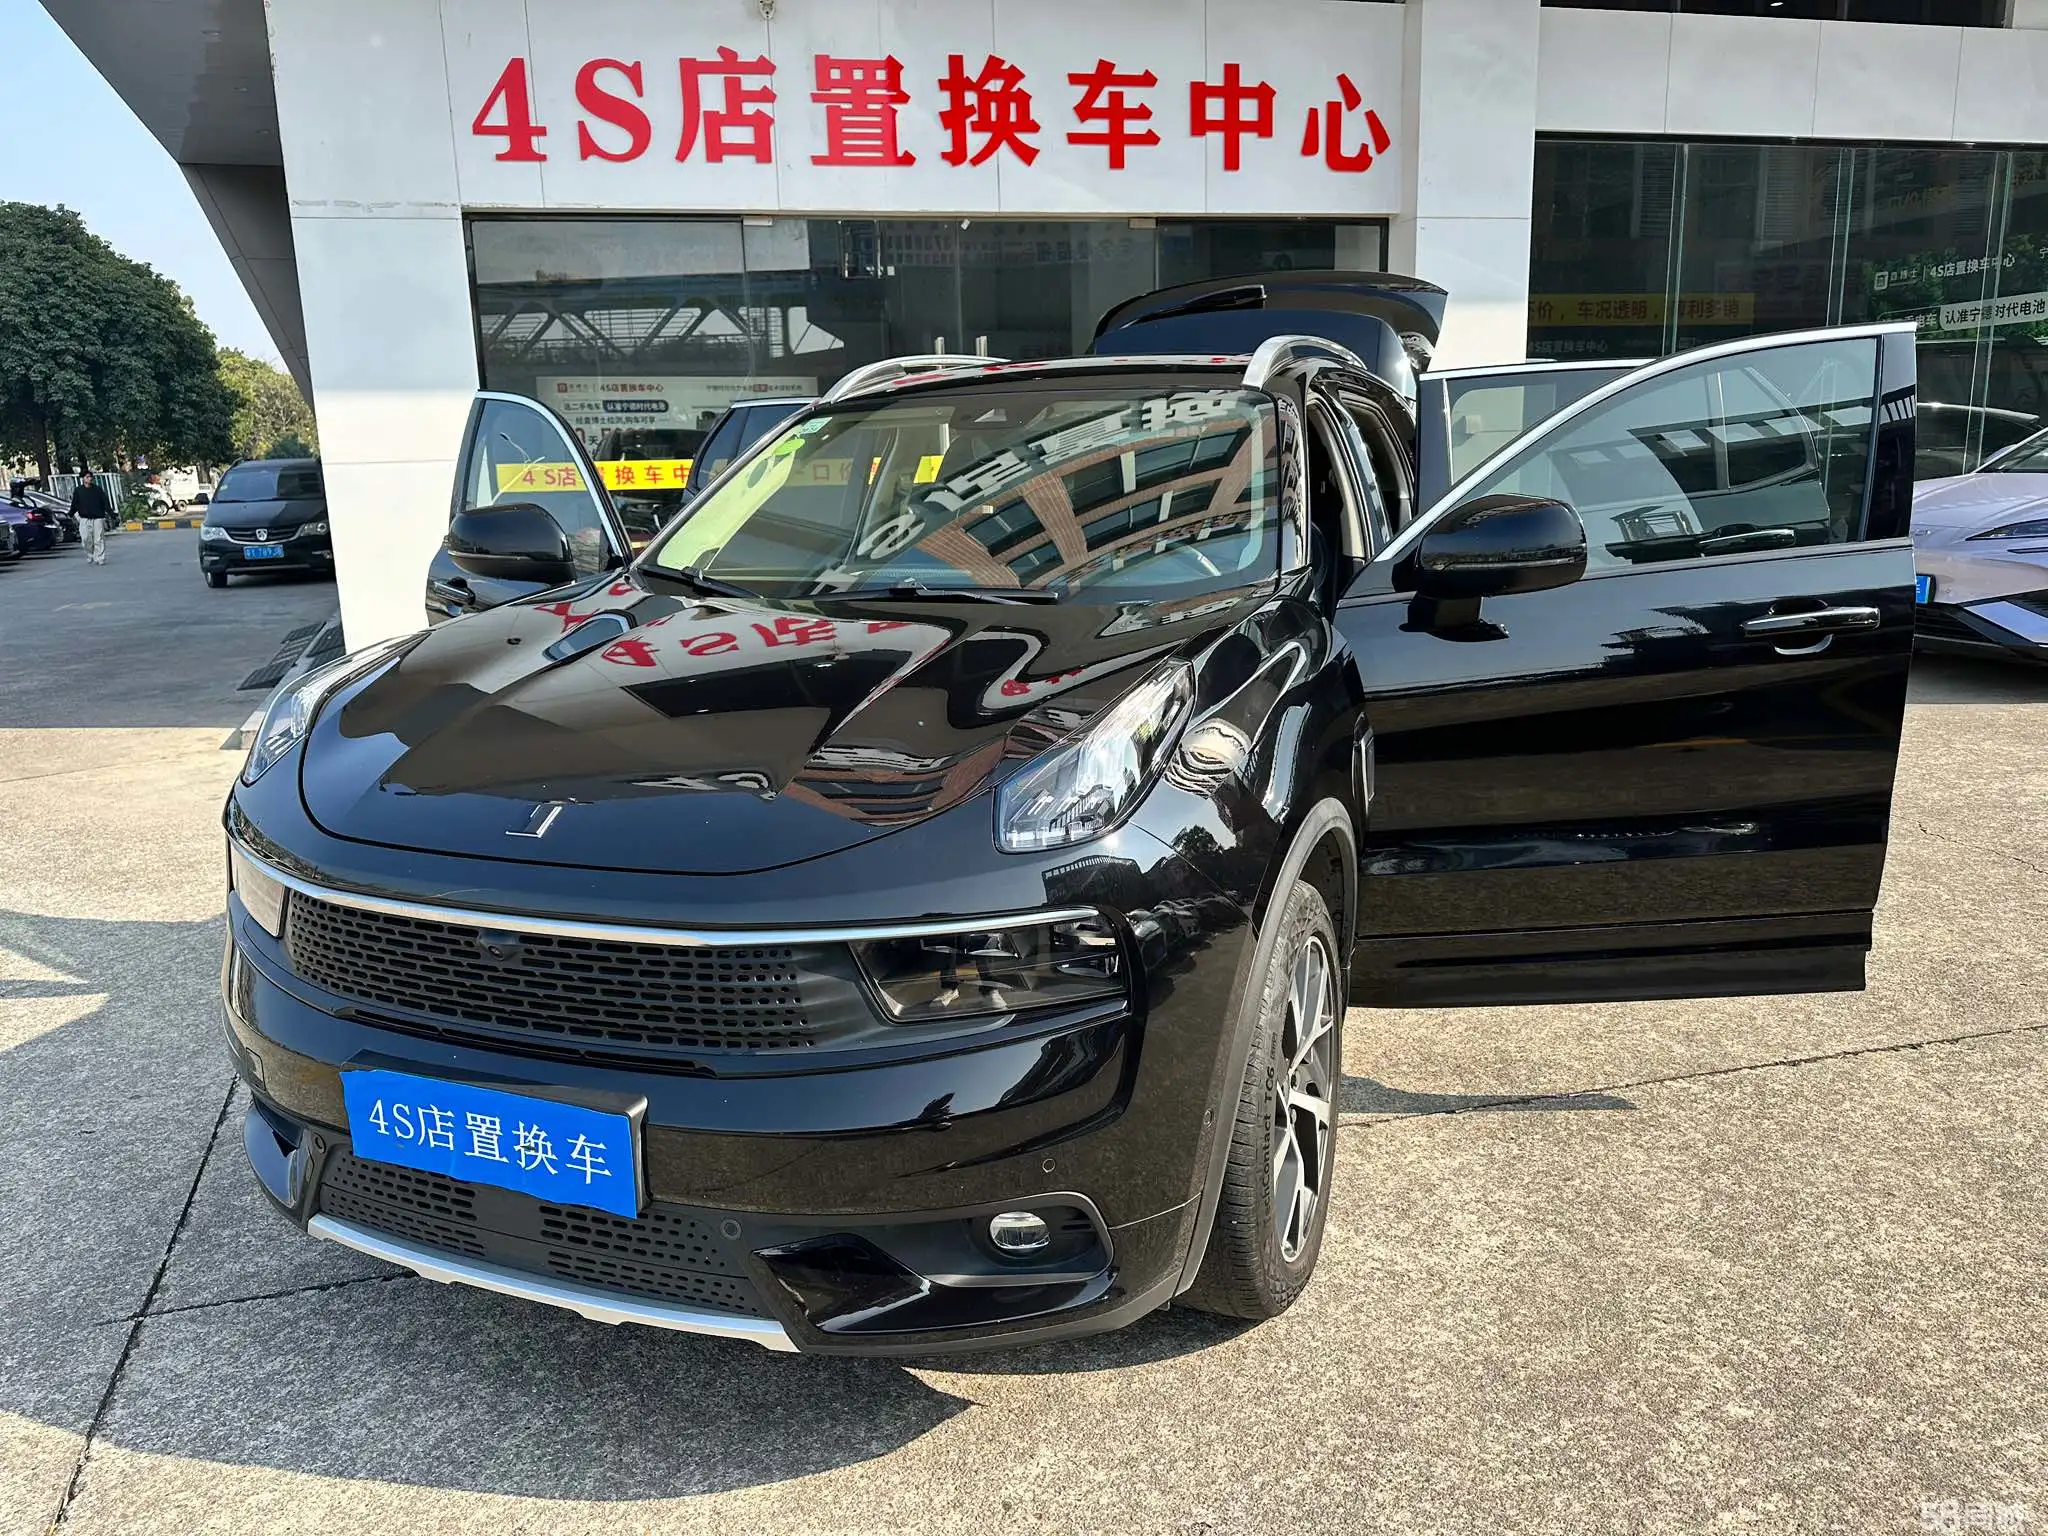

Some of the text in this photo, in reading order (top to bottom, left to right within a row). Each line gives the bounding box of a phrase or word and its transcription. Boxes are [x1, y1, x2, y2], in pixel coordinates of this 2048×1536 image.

[472, 45, 1391, 172] 4S店置换车中心
[1263, 1065, 1275, 1103] TC6
[368, 1099, 612, 1185] 4S店置换车
